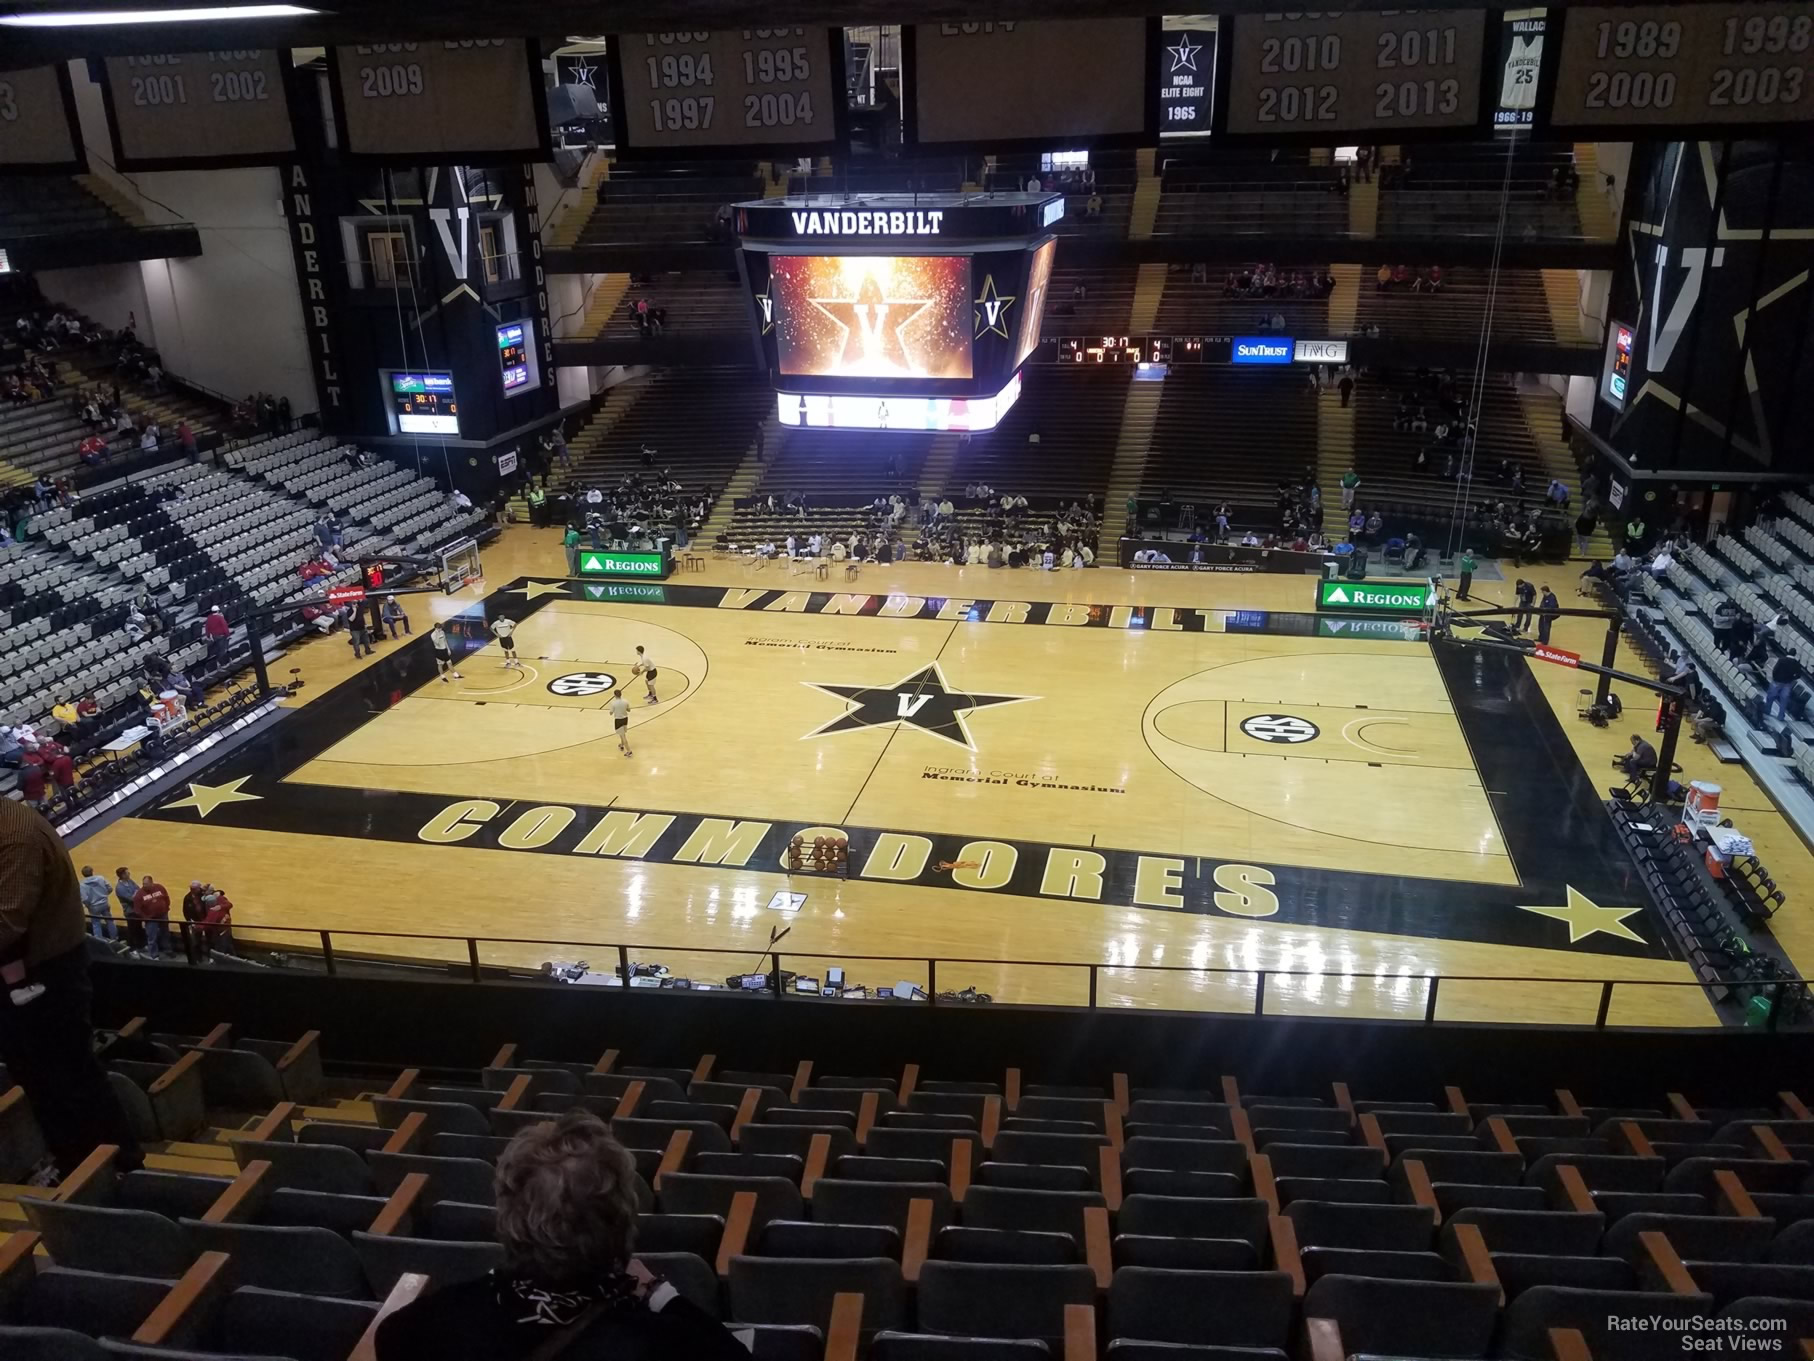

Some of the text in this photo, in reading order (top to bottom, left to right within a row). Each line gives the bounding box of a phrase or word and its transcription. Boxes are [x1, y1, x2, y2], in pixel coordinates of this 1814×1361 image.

[1513, 21, 1545, 32] WALLAC
[1597, 15, 1814, 58] 1989 1998
[1261, 28, 1456, 73] 2010 2011
[647, 47, 810, 88] 1994 1995
[360, 64, 423, 97] 2009
[1173, 75, 1193, 86] NCAA
[1515, 69, 1533, 84] 25
[132, 70, 268, 106] 2001 2002
[1161, 86, 1204, 98] ELITE EIGHT
[1586, 66, 1804, 108] 2000 2003
[1258, 79, 1460, 122] 2012 2013
[650, 92, 814, 131] 1997 2004
[1168, 106, 1196, 120] 1965
[1494, 111, 1533, 122] 1966-19
[792, 211, 943, 235] VANDERBILT
[523, 163, 554, 386] OMMODORES
[292, 165, 340, 407] ANDERBILT
[1071, 341, 1077, 350] 4
[1103, 337, 1128, 347] 30:17
[1154, 340, 1160, 350] 4
[1076, 352, 1082, 362] 0
[1097, 352, 1103, 362] 0
[1134, 352, 1140, 362] 0
[1153, 352, 1160, 362] 0
[1238, 345, 1288, 356] SUNTRUST
[1303, 344, 1337, 358] IMG
[416, 394, 437, 403] 30:17
[605, 559, 659, 572] REGIONS
[1353, 591, 1420, 606] REGIONS
[718, 588, 1236, 632] VANDERBILT
[744, 640, 897, 654] Memorial Gymnasium
[923, 765, 981, 777] Ingram
[990, 770, 1036, 780] Court
[921, 772, 1126, 794] Memorial Gymnasium
[418, 799, 1280, 917] COMMODORES
